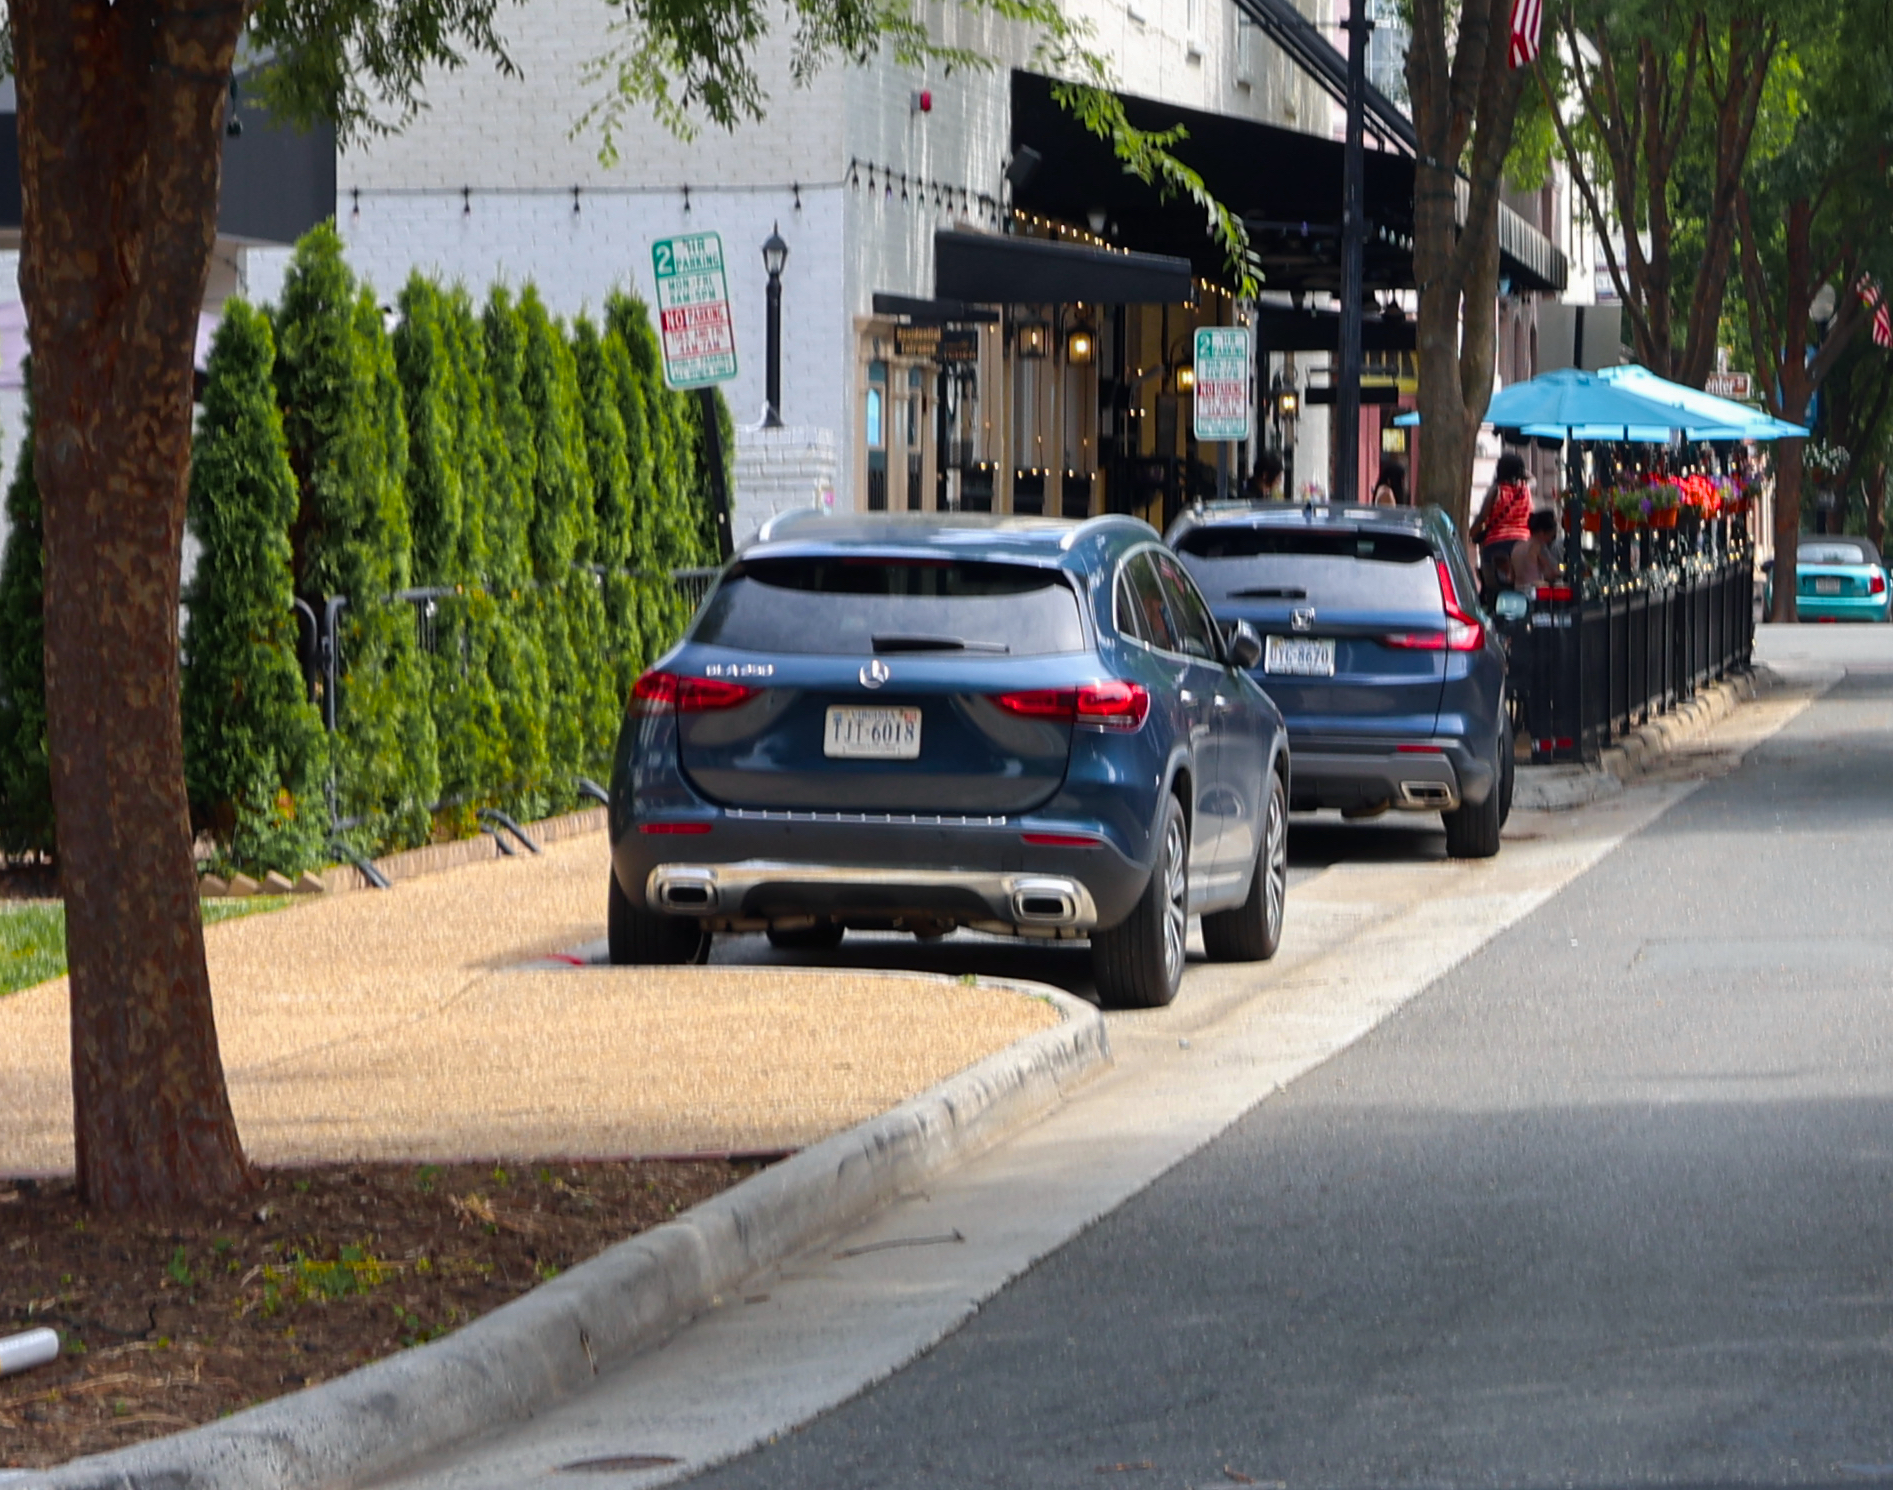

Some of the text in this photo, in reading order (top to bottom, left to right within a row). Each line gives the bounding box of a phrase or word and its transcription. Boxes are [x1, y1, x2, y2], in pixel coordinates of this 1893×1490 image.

[655, 245, 673, 275] 2
[676, 255, 719, 274] PARKING
[666, 304, 723, 331] NO PARKING
[1199, 333, 1211, 355] 2
[1705, 376, 1735, 395] enter
